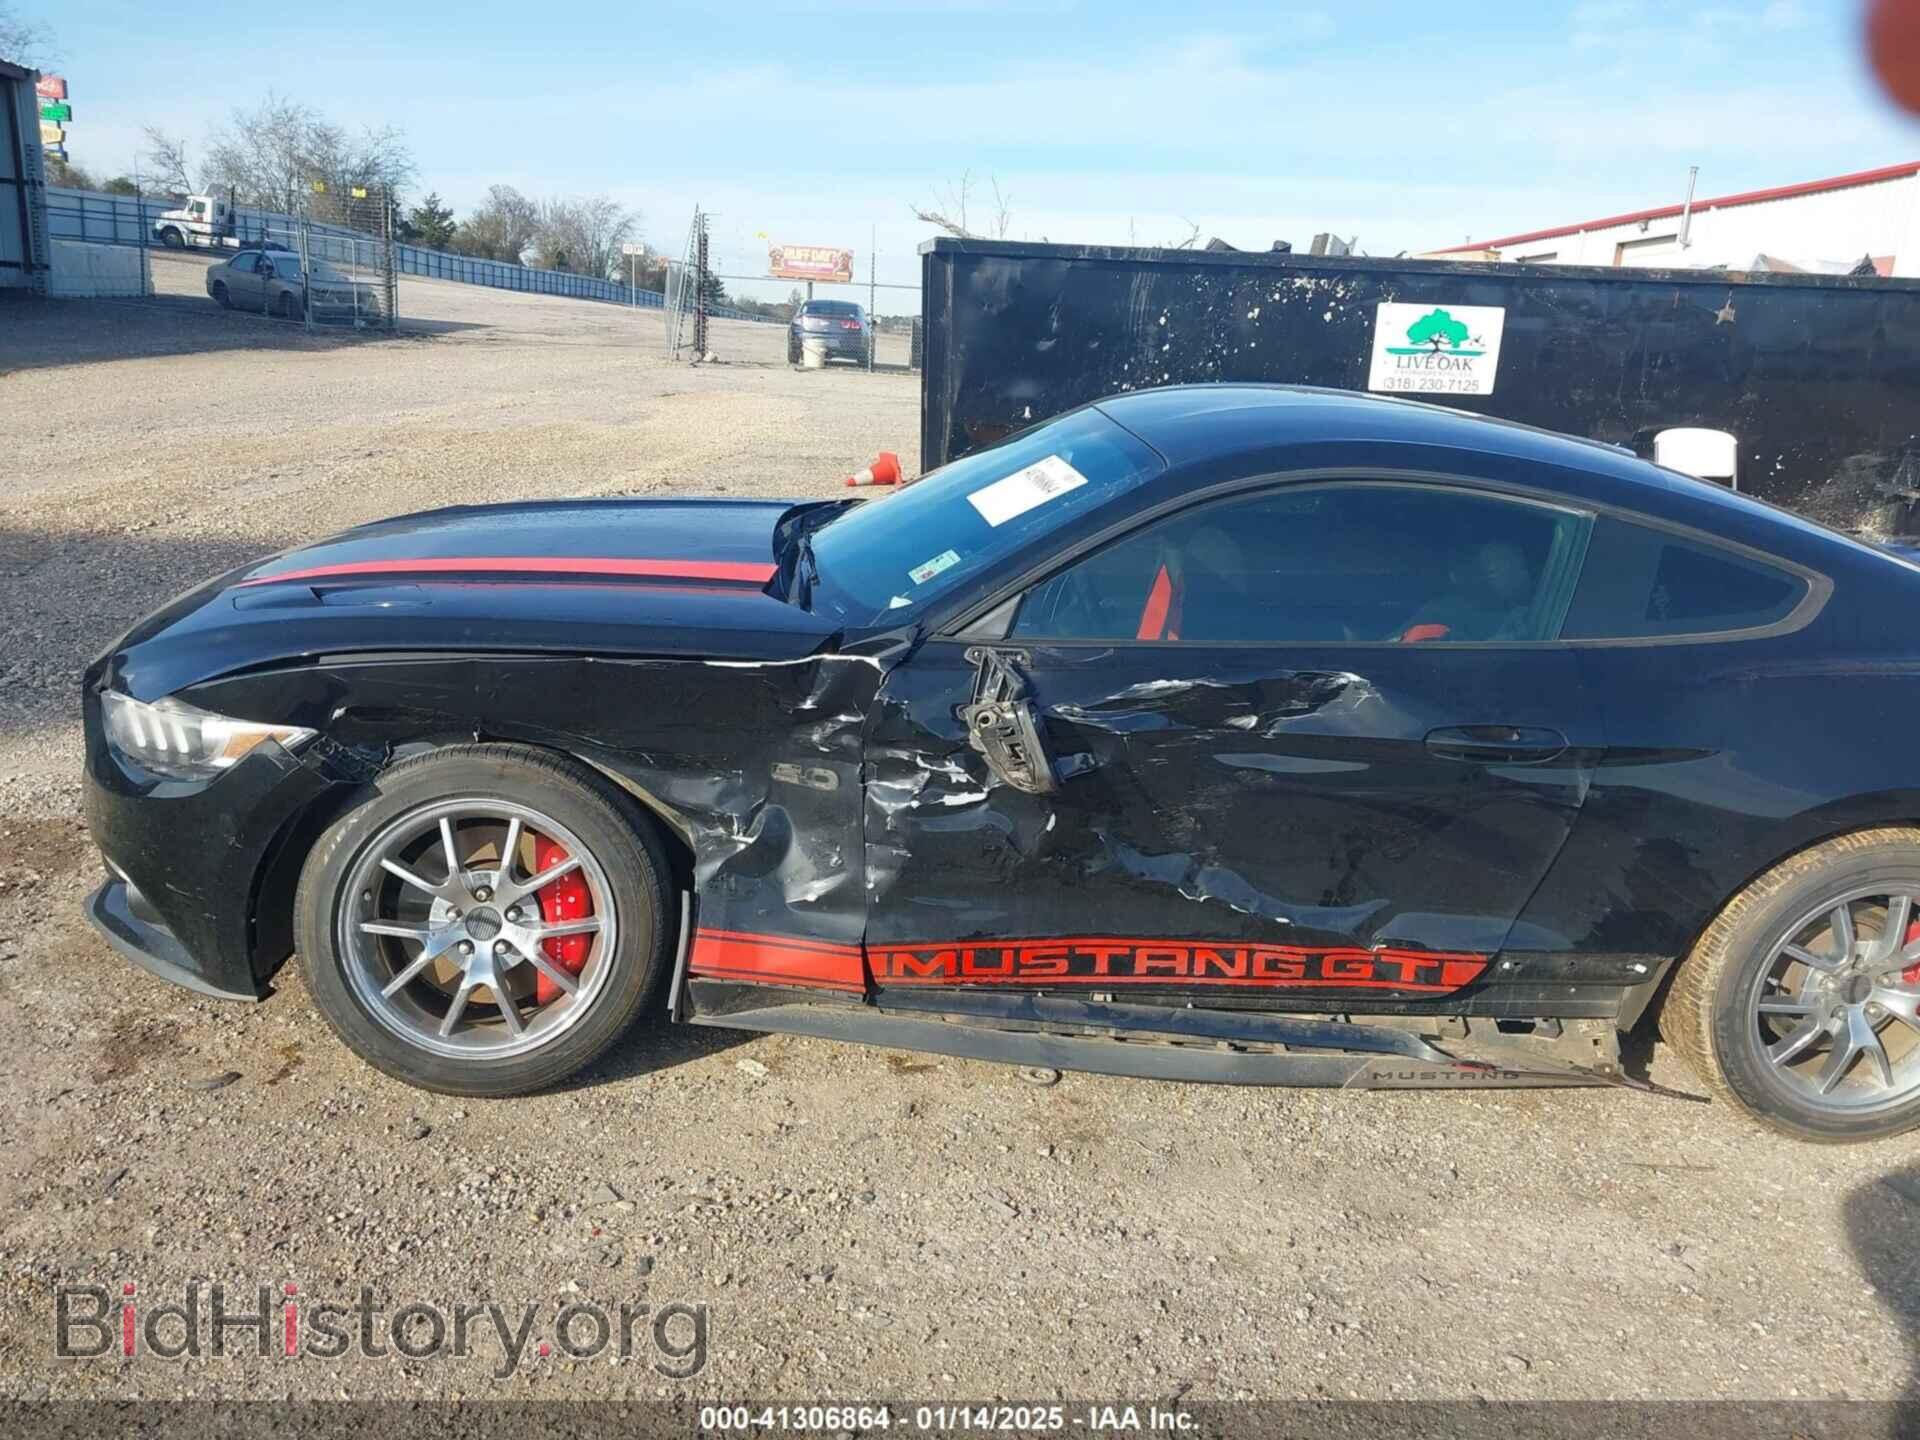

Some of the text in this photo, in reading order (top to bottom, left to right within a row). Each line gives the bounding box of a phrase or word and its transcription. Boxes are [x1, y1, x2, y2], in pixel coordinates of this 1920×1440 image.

[1396, 355, 1473, 371] LIVE OAK
[1419, 378, 1480, 392] 230-7125
[892, 948, 1439, 983] MUSTANG GT
[1372, 1071, 1520, 1081] MUSTANG
